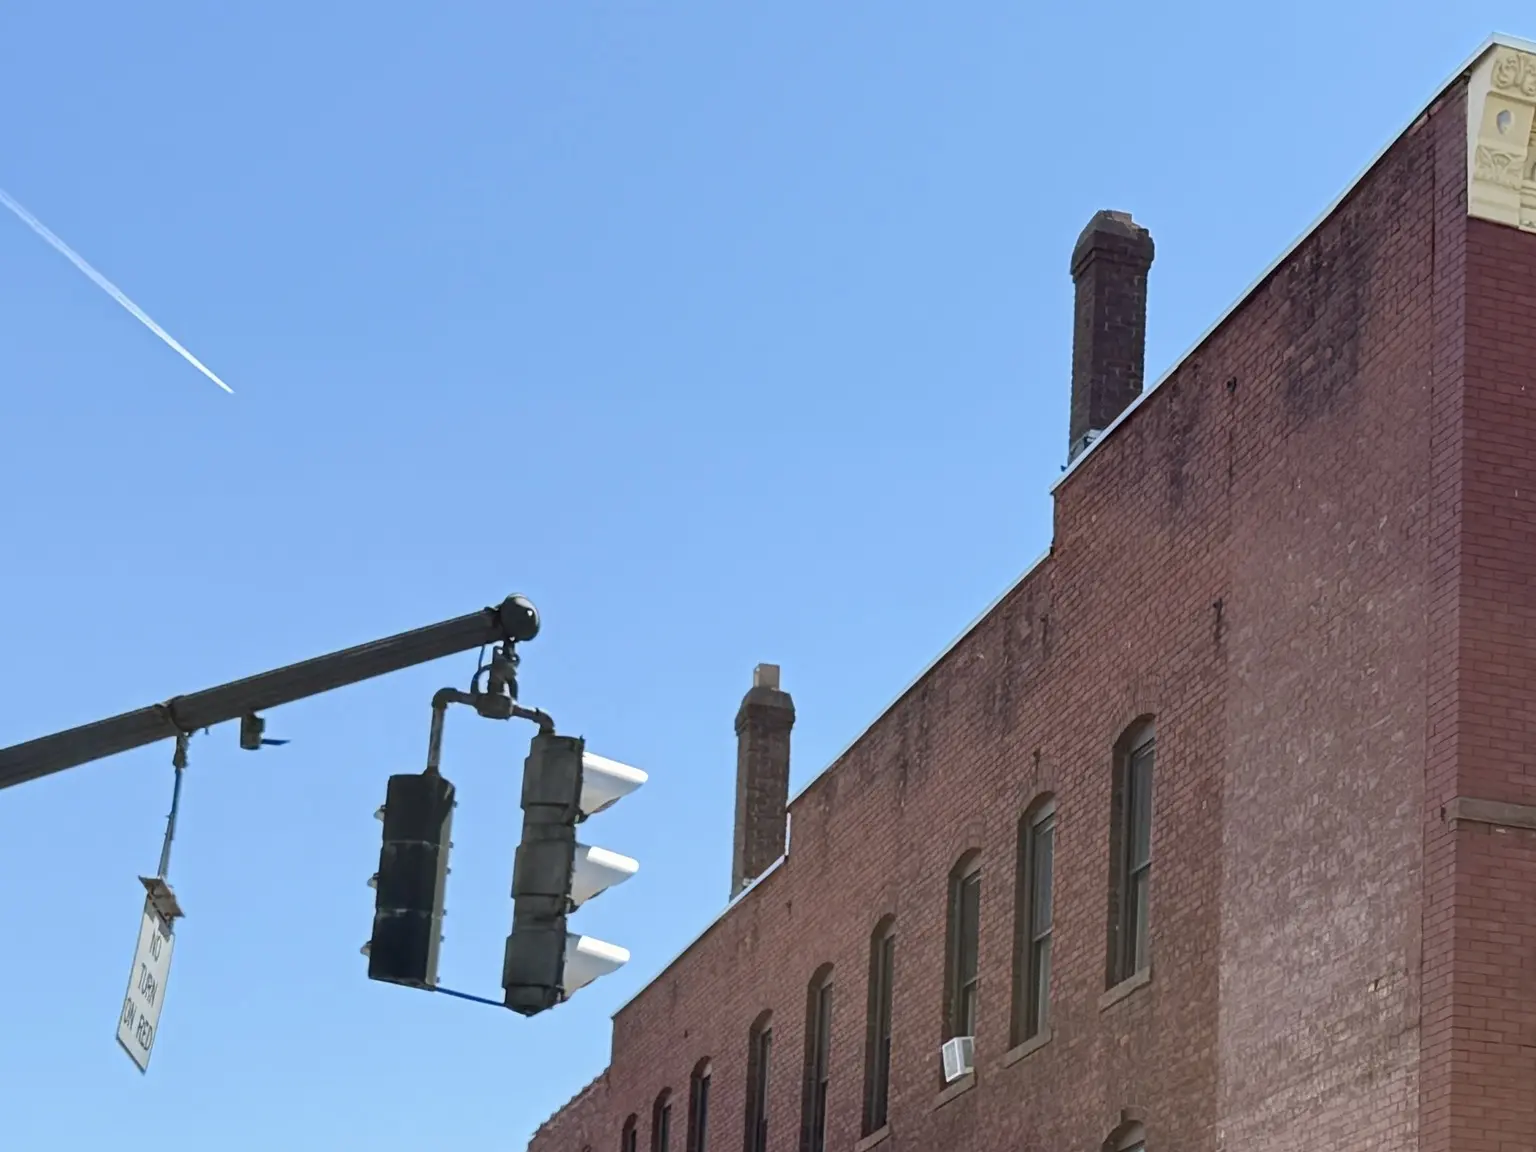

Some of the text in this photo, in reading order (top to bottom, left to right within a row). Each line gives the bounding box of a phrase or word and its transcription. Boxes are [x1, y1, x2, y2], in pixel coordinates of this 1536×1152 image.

[149, 932, 163, 962] NO
[137, 962, 158, 1008] TURN
[123, 997, 153, 1051] ON RED
